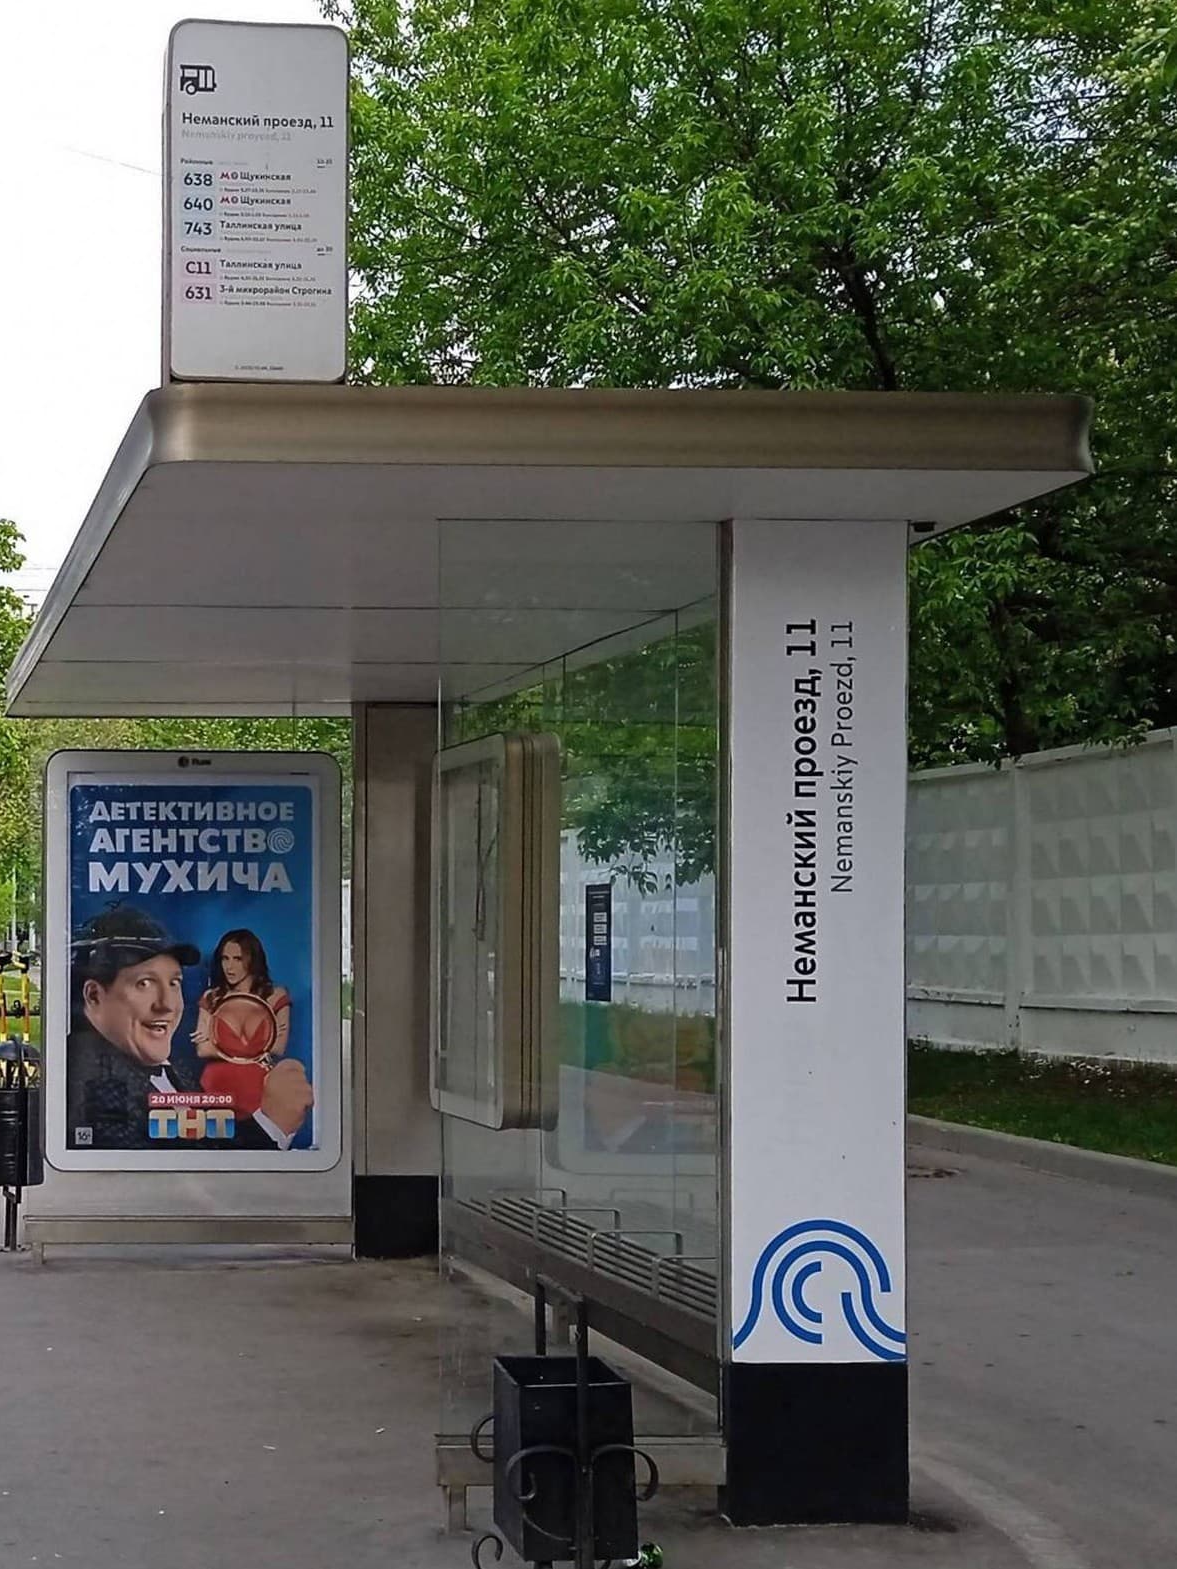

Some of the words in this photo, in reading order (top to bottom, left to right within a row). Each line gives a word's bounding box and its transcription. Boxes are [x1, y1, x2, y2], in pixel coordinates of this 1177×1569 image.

[182, 112, 260, 127] Неманский
[263, 116, 317, 129] проезд,
[320, 116, 334, 128] 11
[183, 172, 213, 187] 638
[240, 173, 291, 182] Щукинская
[183, 197, 213, 211] 640
[240, 196, 291, 206] Щукинская
[184, 222, 212, 236] 743
[220, 221, 273, 231] Таллинская
[274, 223, 302, 232] улица
[220, 259, 273, 269] Таллинская
[274, 262, 302, 271] улица
[185, 286, 213, 300] 631
[220, 284, 234, 294] 3-й
[236, 286, 290, 296] микрорайон
[291, 286, 332, 296] Строгина
[786, 619, 817, 656] 11
[830, 621, 853, 648] 11
[830, 655, 857, 747] Proezd,
[793, 666, 823, 798] проезд,
[88, 800, 295, 823] ДЕТЕКТИВНОЕ
[830, 754, 859, 893] Nemanskiy
[88, 827, 295, 854] АГЕНТСТВО
[88, 860, 294, 893] МУХИЧА
[786, 809, 817, 1003] Неманский
[151, 1095, 166, 1104] 20
[167, 1095, 201, 1104] ИЮНЯ
[202, 1095, 233, 1104] 20:00
[149, 1109, 236, 1139] ТНТ
